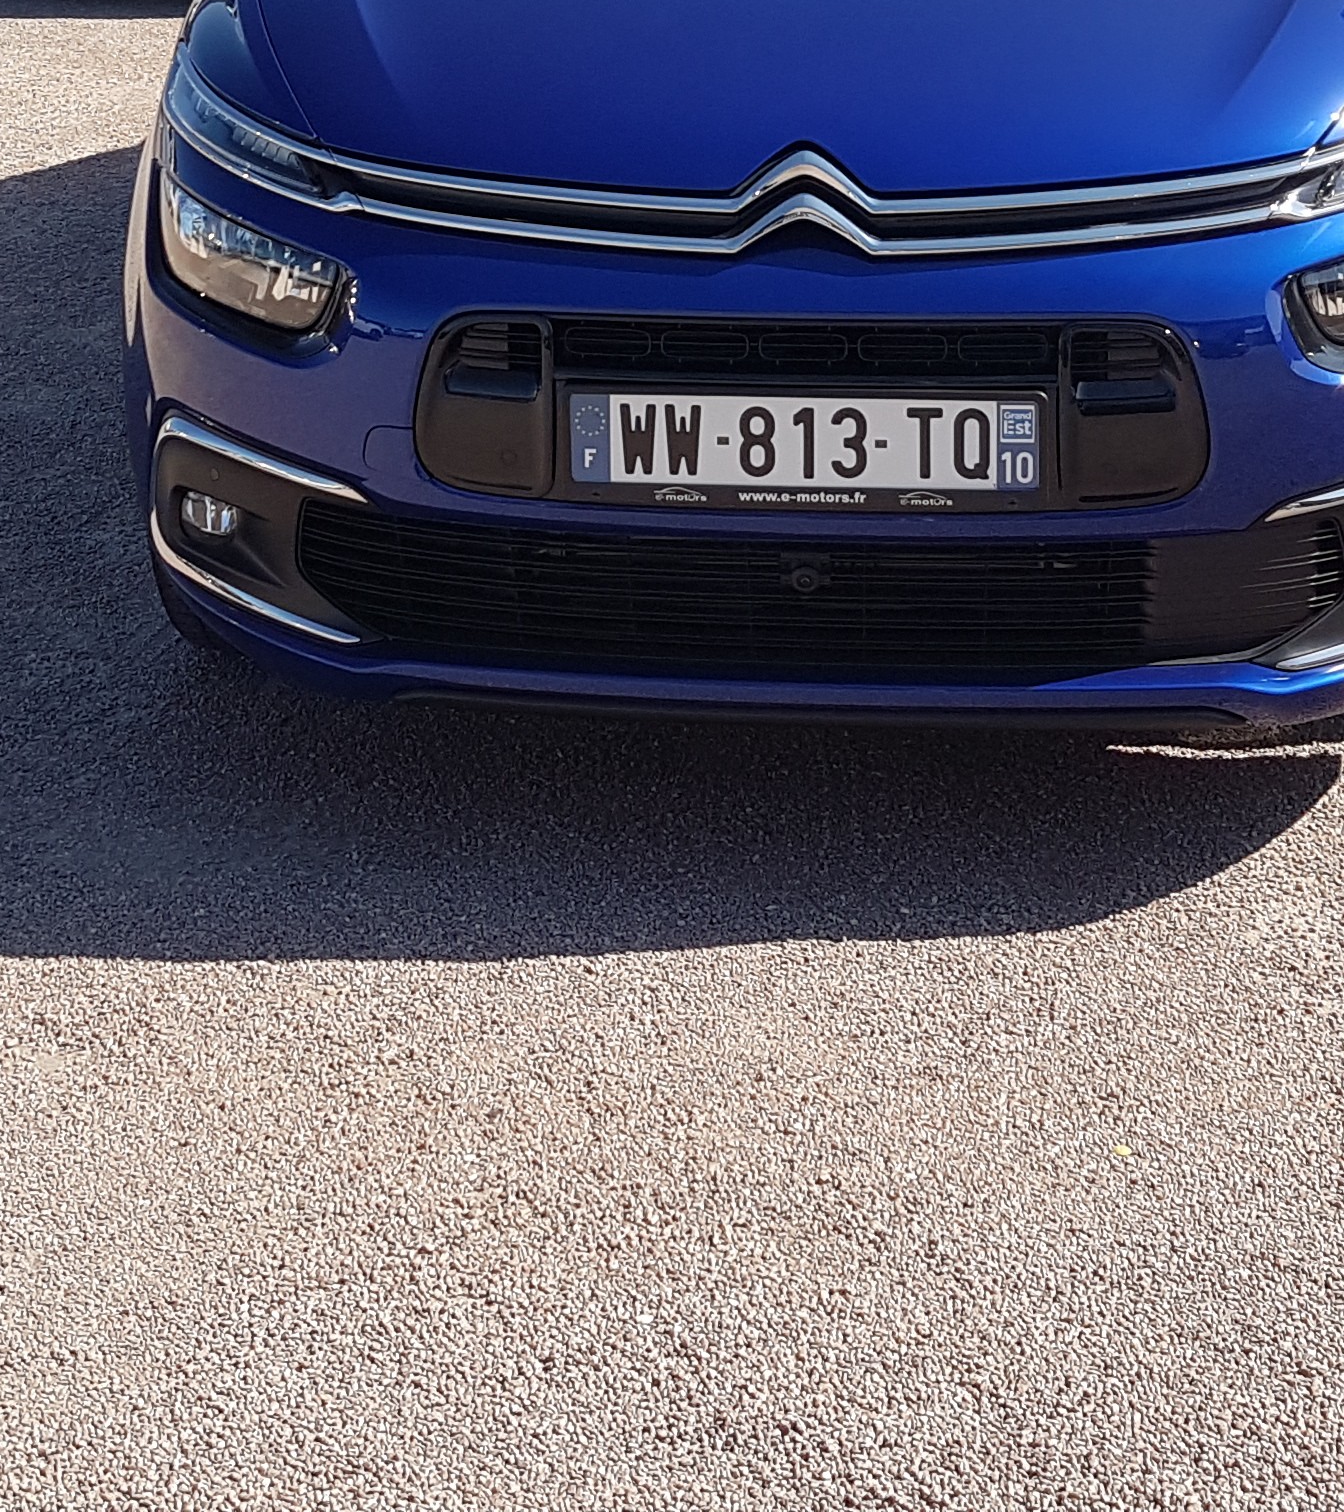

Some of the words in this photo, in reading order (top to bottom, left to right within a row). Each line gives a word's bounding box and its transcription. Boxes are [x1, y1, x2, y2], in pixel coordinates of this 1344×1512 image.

[1003, 411, 1032, 420] Grand
[1003, 419, 1032, 435] Est
[583, 448, 597, 469] F
[1001, 451, 1034, 484] 10
[739, 490, 867, 504] www.e-motors.fr
